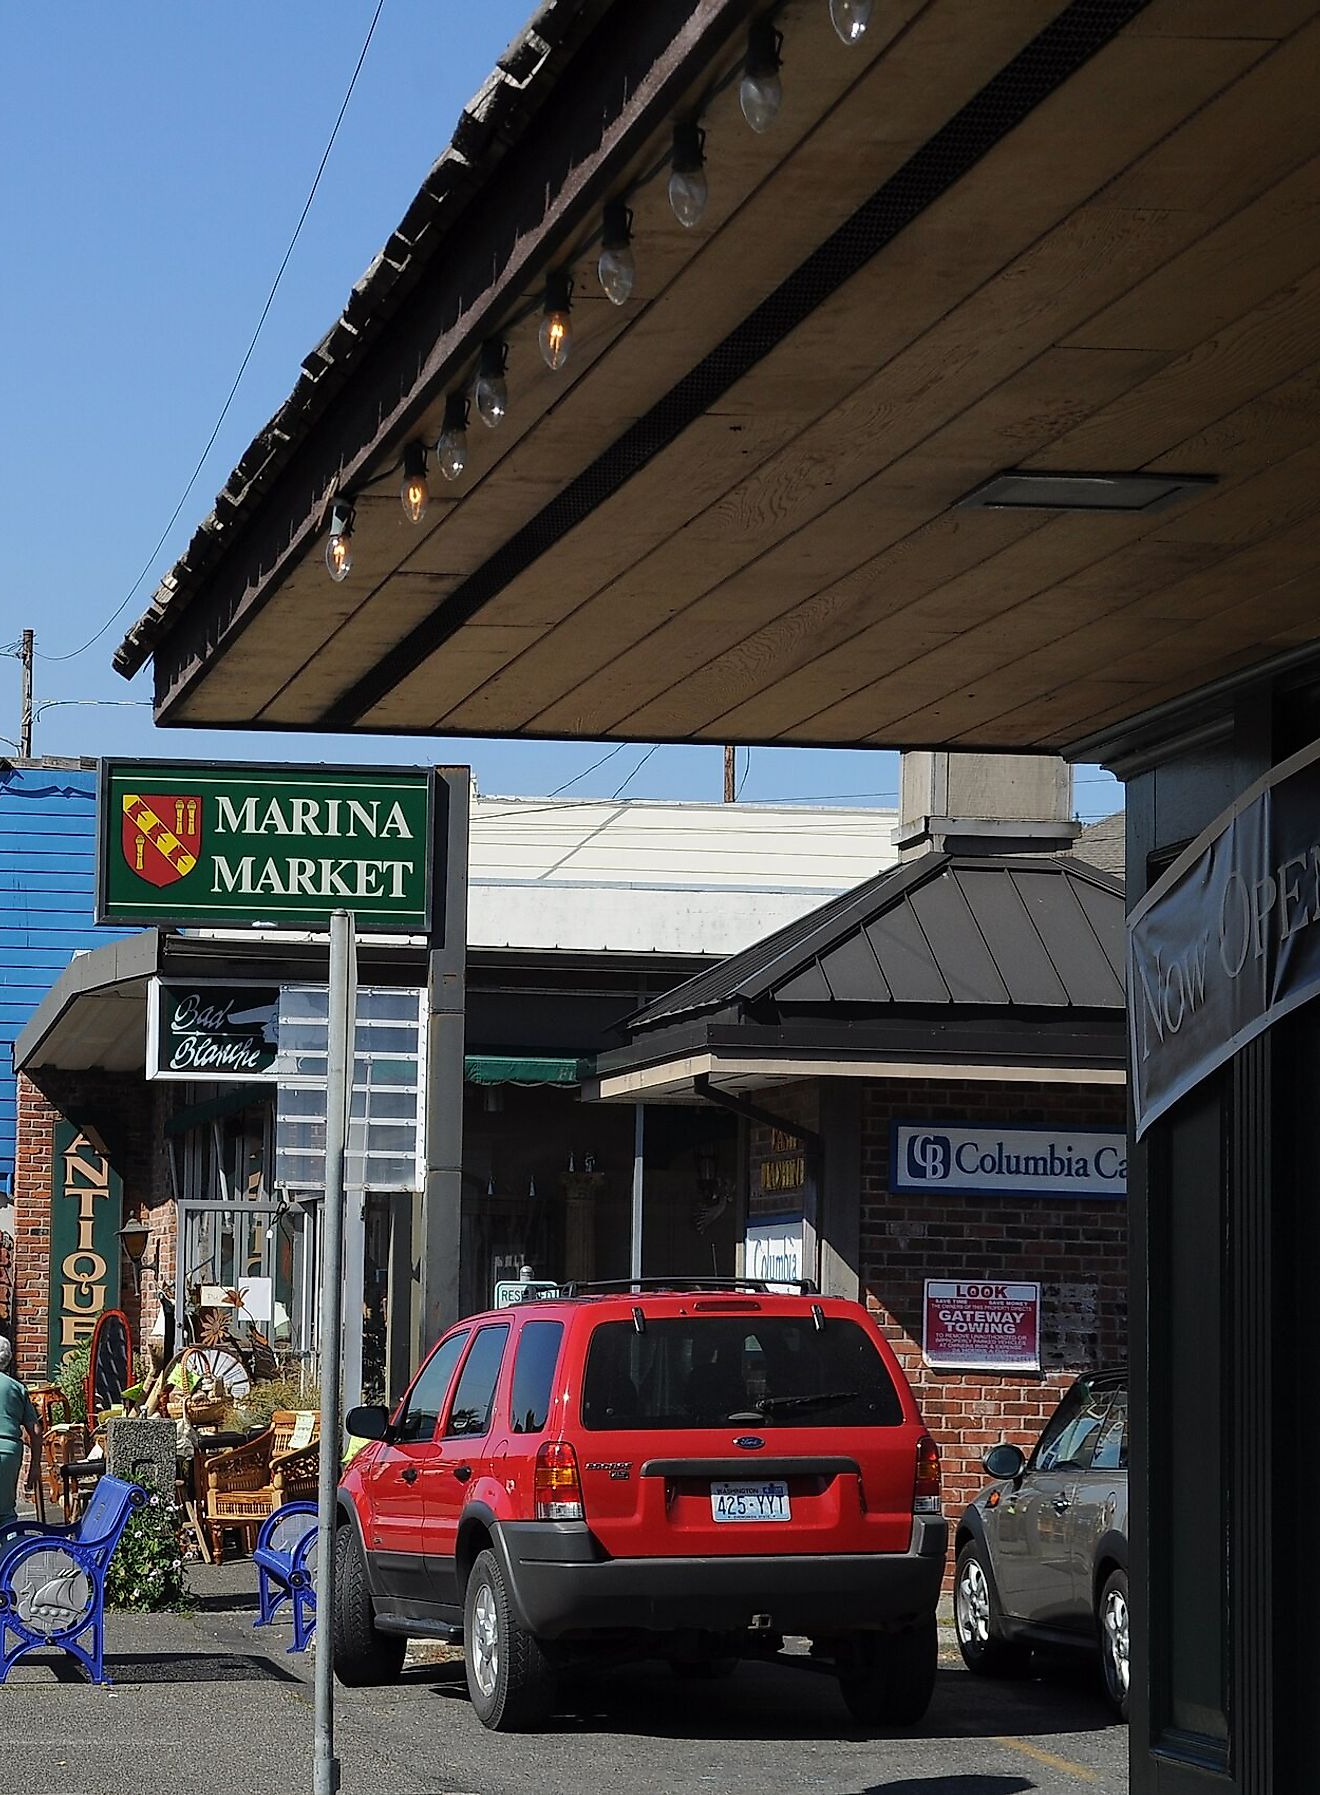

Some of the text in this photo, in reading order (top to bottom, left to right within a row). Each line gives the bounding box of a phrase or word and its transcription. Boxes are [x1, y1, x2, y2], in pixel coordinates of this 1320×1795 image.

[213, 796, 414, 838] MARINA
[209, 855, 414, 898] MARKET
[171, 994, 234, 1030] Bad
[1140, 928, 1210, 1061] NOW
[170, 1036, 260, 1069] Blanche
[954, 1141, 1091, 1178] Columbia
[753, 1234, 797, 1280] Columbia
[955, 1285, 1008, 1299] LOOK
[938, 1310, 1025, 1323] GATEWAY
[944, 1322, 1017, 1334] TOWING
